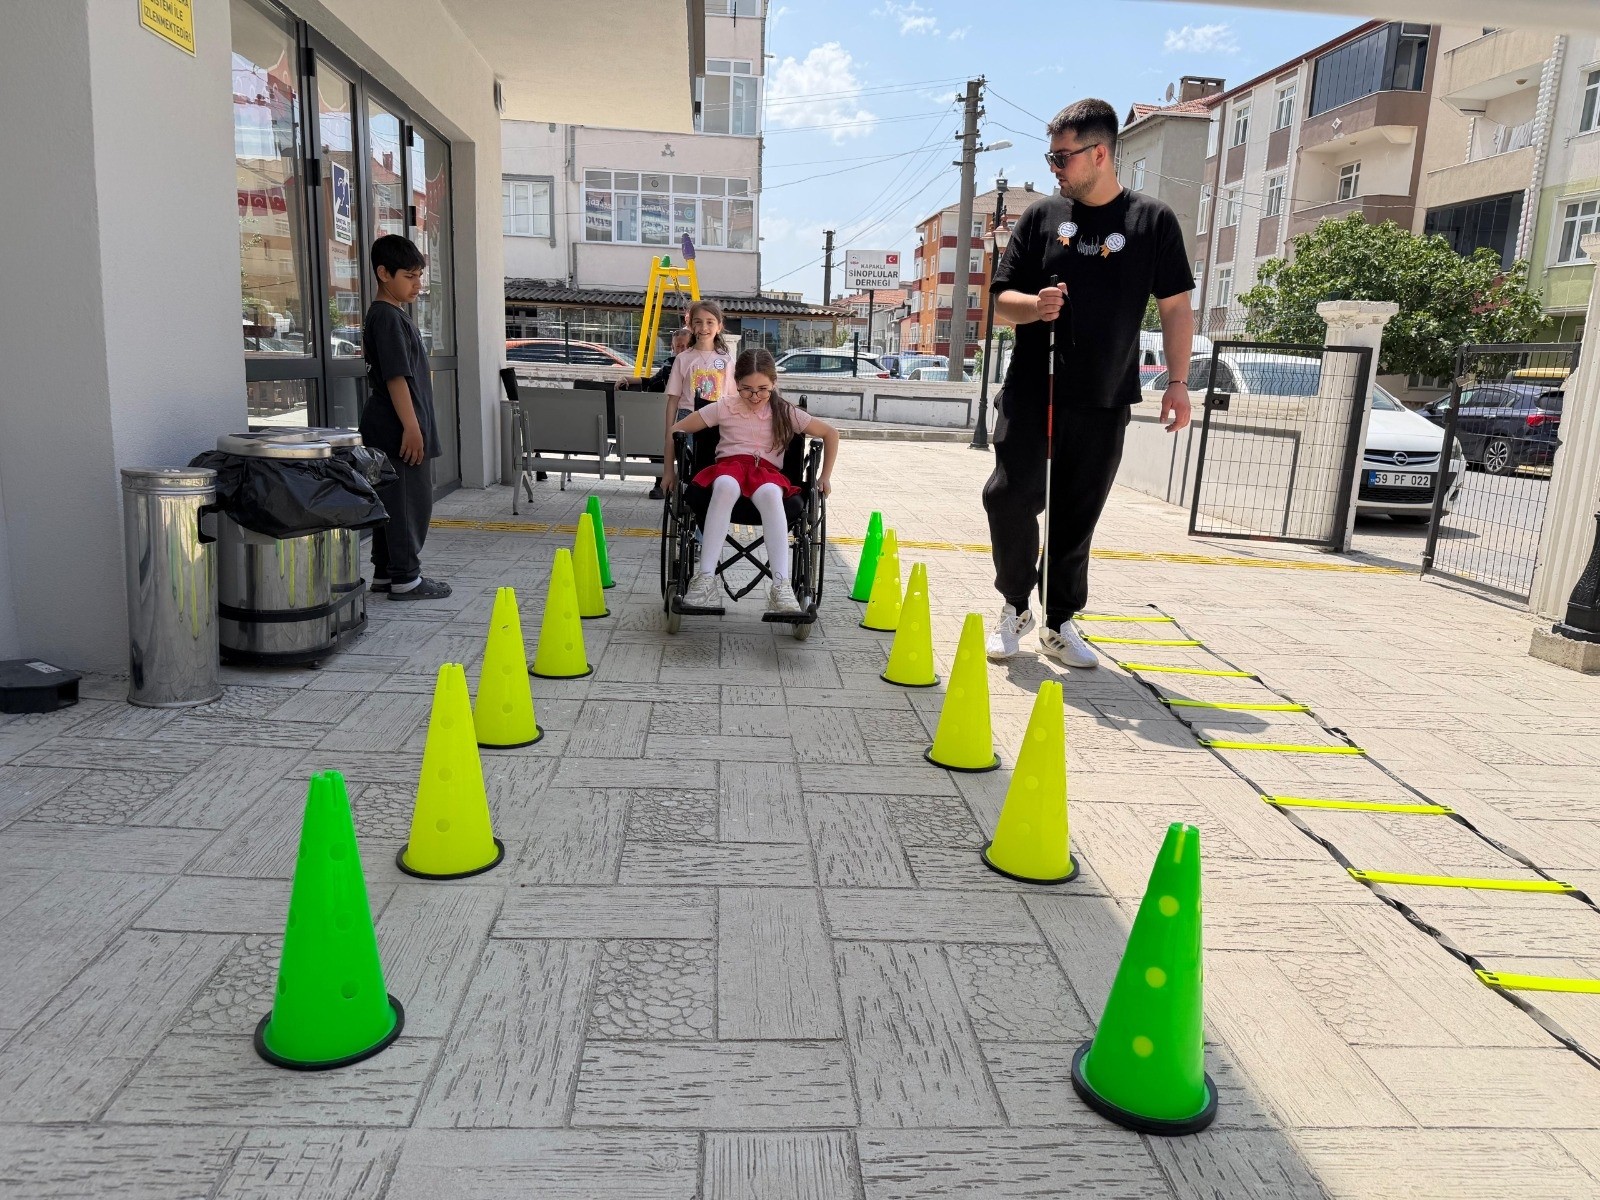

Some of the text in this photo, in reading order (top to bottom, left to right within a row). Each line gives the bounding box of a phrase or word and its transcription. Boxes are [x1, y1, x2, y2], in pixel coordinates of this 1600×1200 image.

[174, 4, 183, 21] İLE
[848, 268, 899, 278] SİNOPLULAR
[855, 278, 891, 287] DERNEĞİ
[1375, 473, 1429, 486] 59 PF 022
